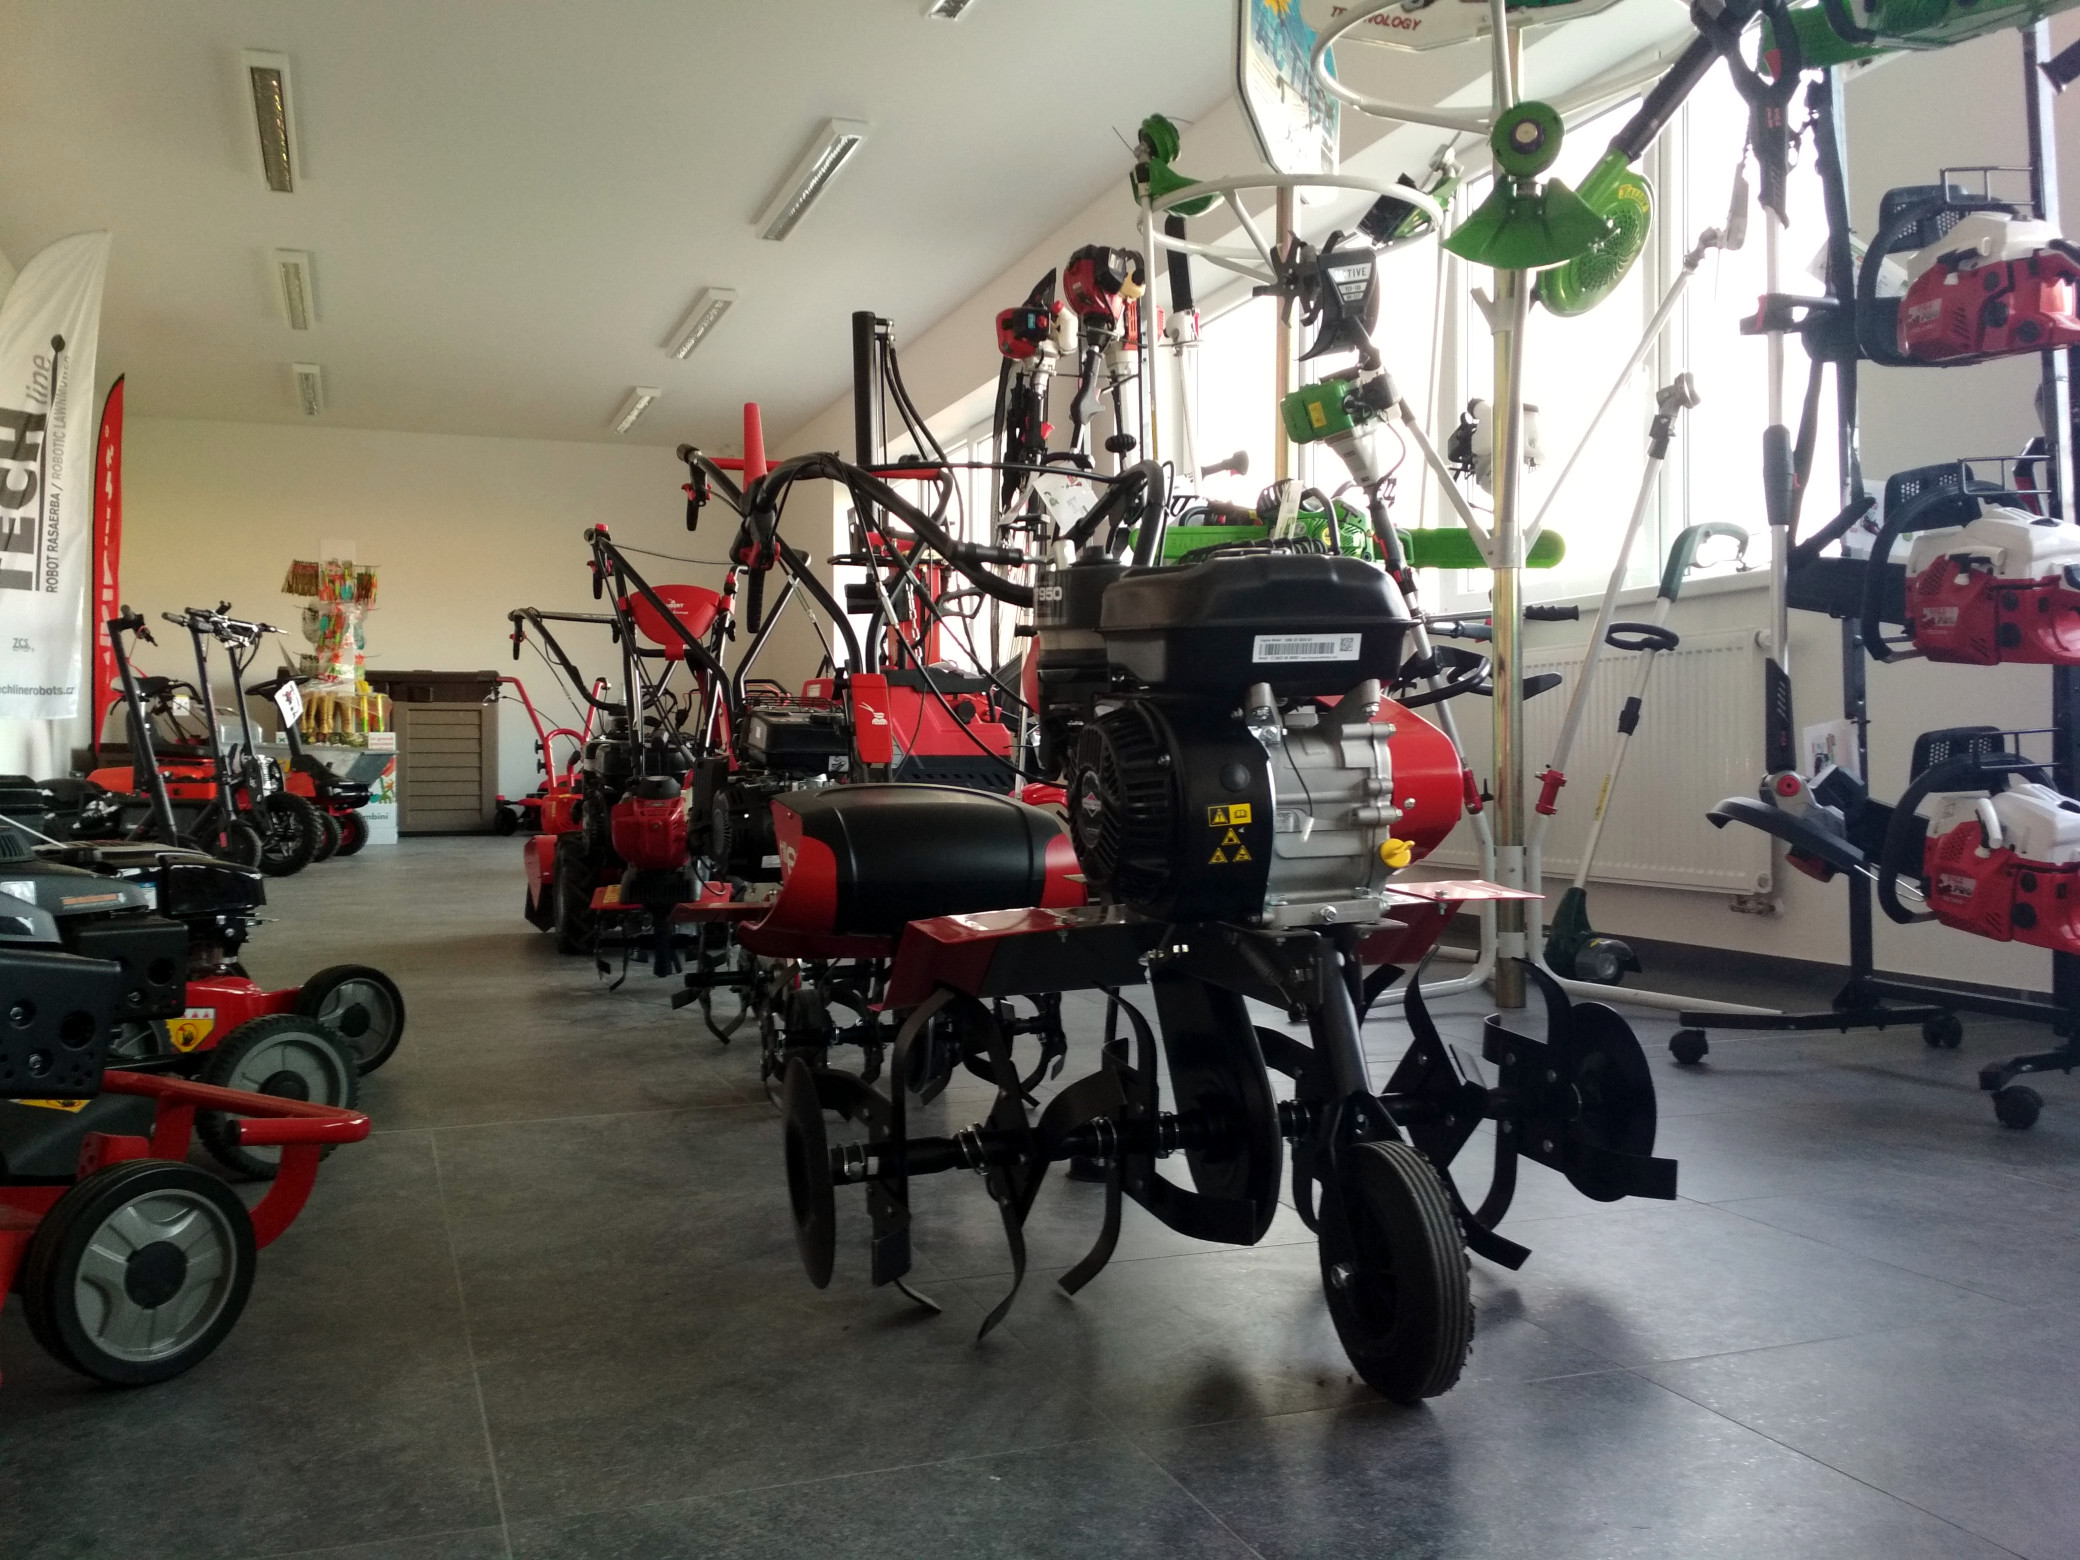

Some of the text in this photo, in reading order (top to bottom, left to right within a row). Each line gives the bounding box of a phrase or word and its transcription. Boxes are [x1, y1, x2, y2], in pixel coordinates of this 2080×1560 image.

[53, 431, 66, 480] ROBOTIC
[47, 493, 61, 552] RASAERBA
[46, 555, 59, 593] ROBOT
